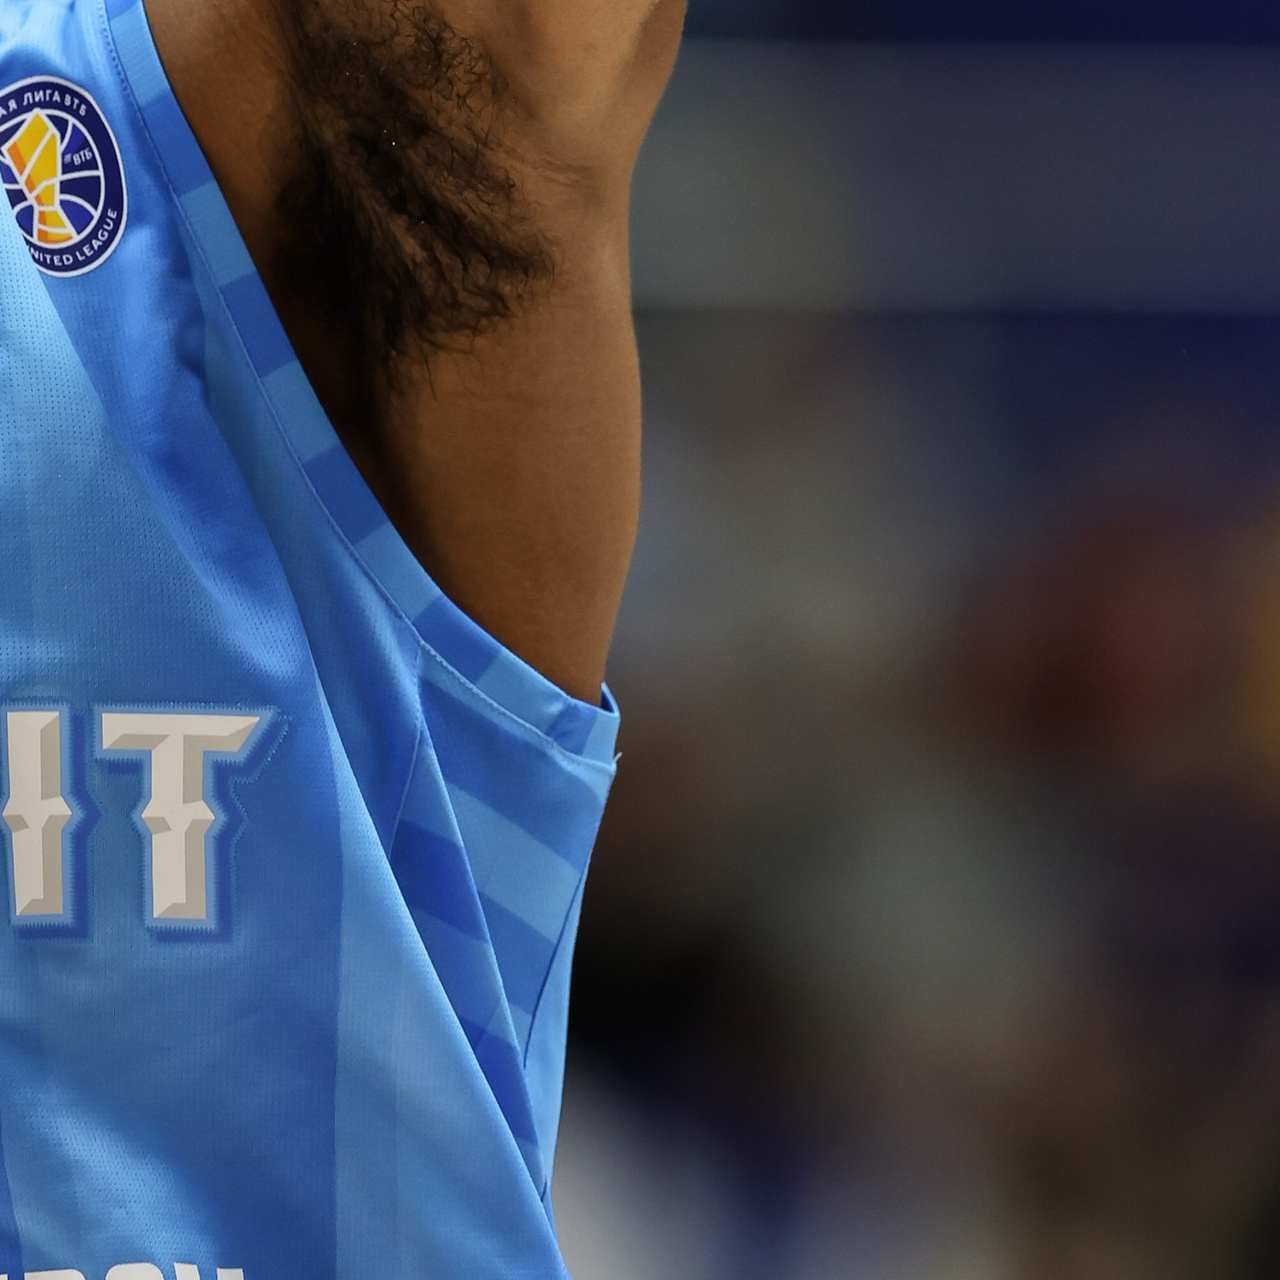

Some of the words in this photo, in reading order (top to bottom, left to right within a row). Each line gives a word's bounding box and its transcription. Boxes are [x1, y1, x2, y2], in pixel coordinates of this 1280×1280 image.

[23, 89, 61, 106] ЛИГА
[64, 94, 87, 116] ВТБ
[72, 147, 93, 166] ВТБ
[27, 246, 73, 266] NITED
[75, 208, 118, 261] LEAGUE
